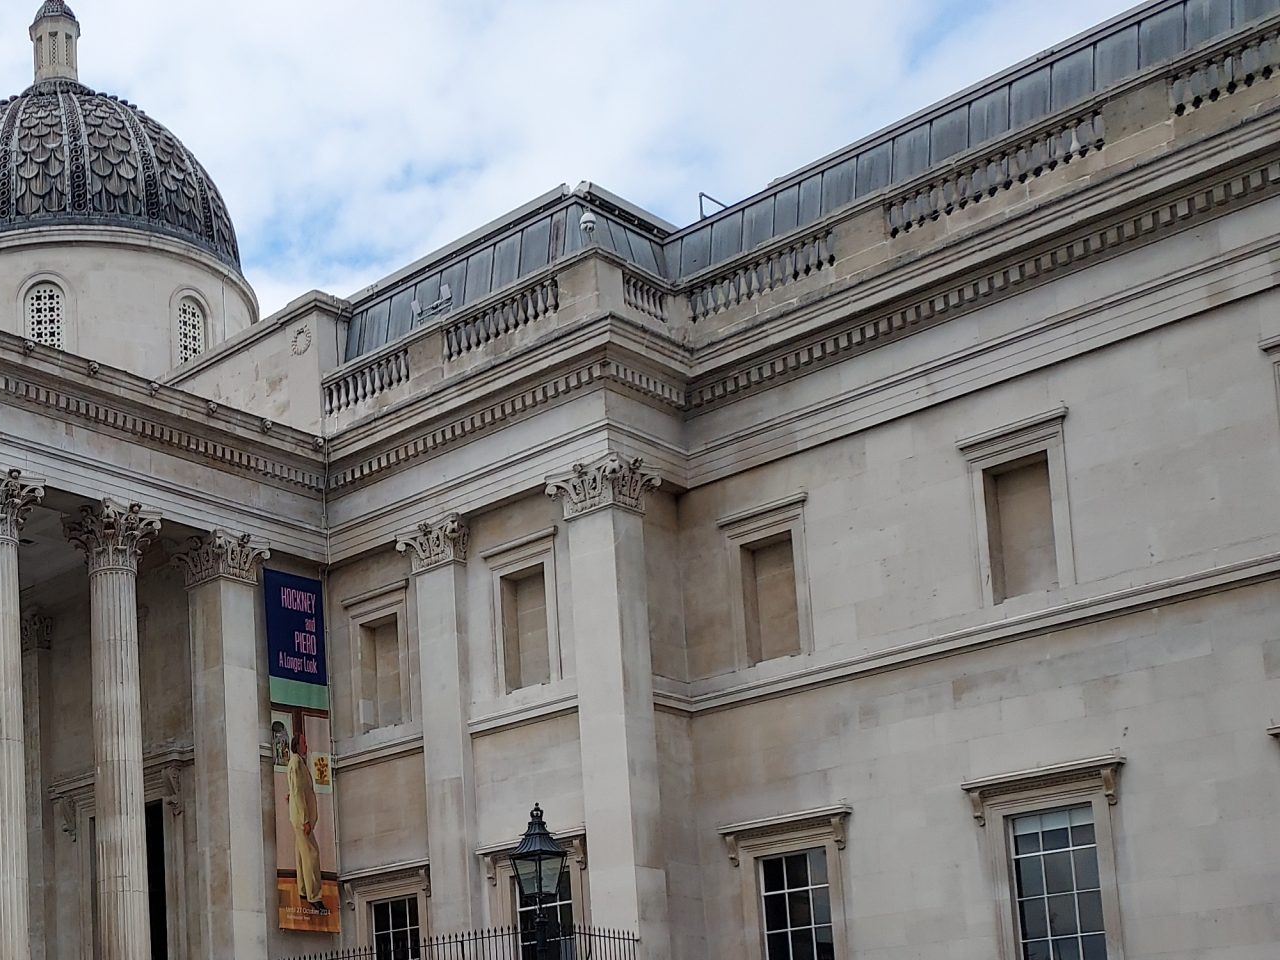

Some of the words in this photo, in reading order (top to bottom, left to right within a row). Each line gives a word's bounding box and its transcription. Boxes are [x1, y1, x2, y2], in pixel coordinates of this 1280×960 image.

[281, 586, 316, 614] HOCKNEY
[305, 617, 316, 632] and
[294, 631, 317, 656] PIERO
[279, 650, 284, 668] A
[284, 652, 303, 673] Longer
[303, 656, 318, 674] Look
